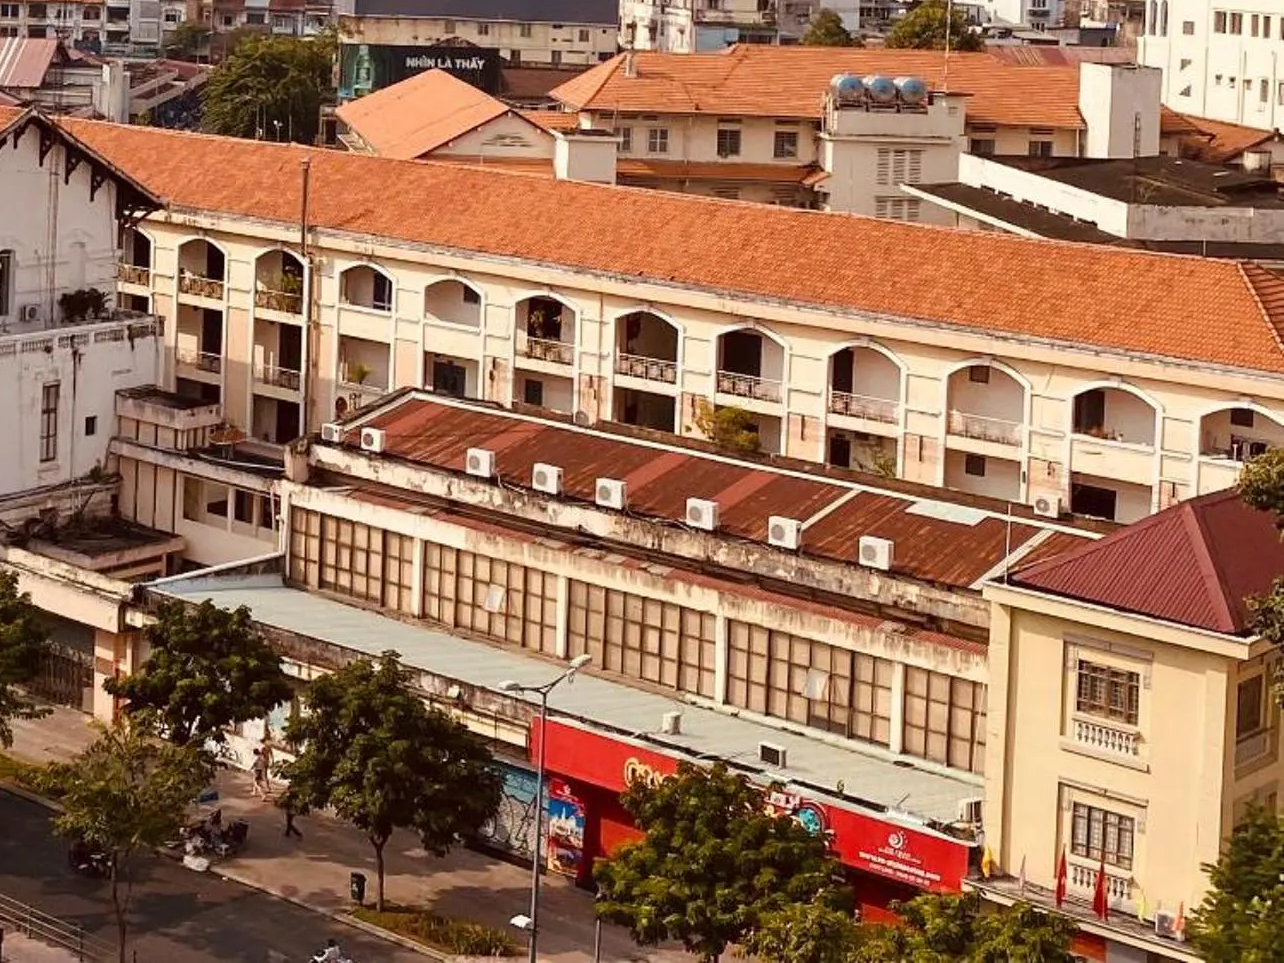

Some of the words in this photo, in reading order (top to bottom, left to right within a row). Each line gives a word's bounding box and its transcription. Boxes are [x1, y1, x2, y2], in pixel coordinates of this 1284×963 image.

[405, 55, 435, 68] NHÌN
[437, 56, 452, 69] LÀ
[455, 56, 485, 70] THẤY
